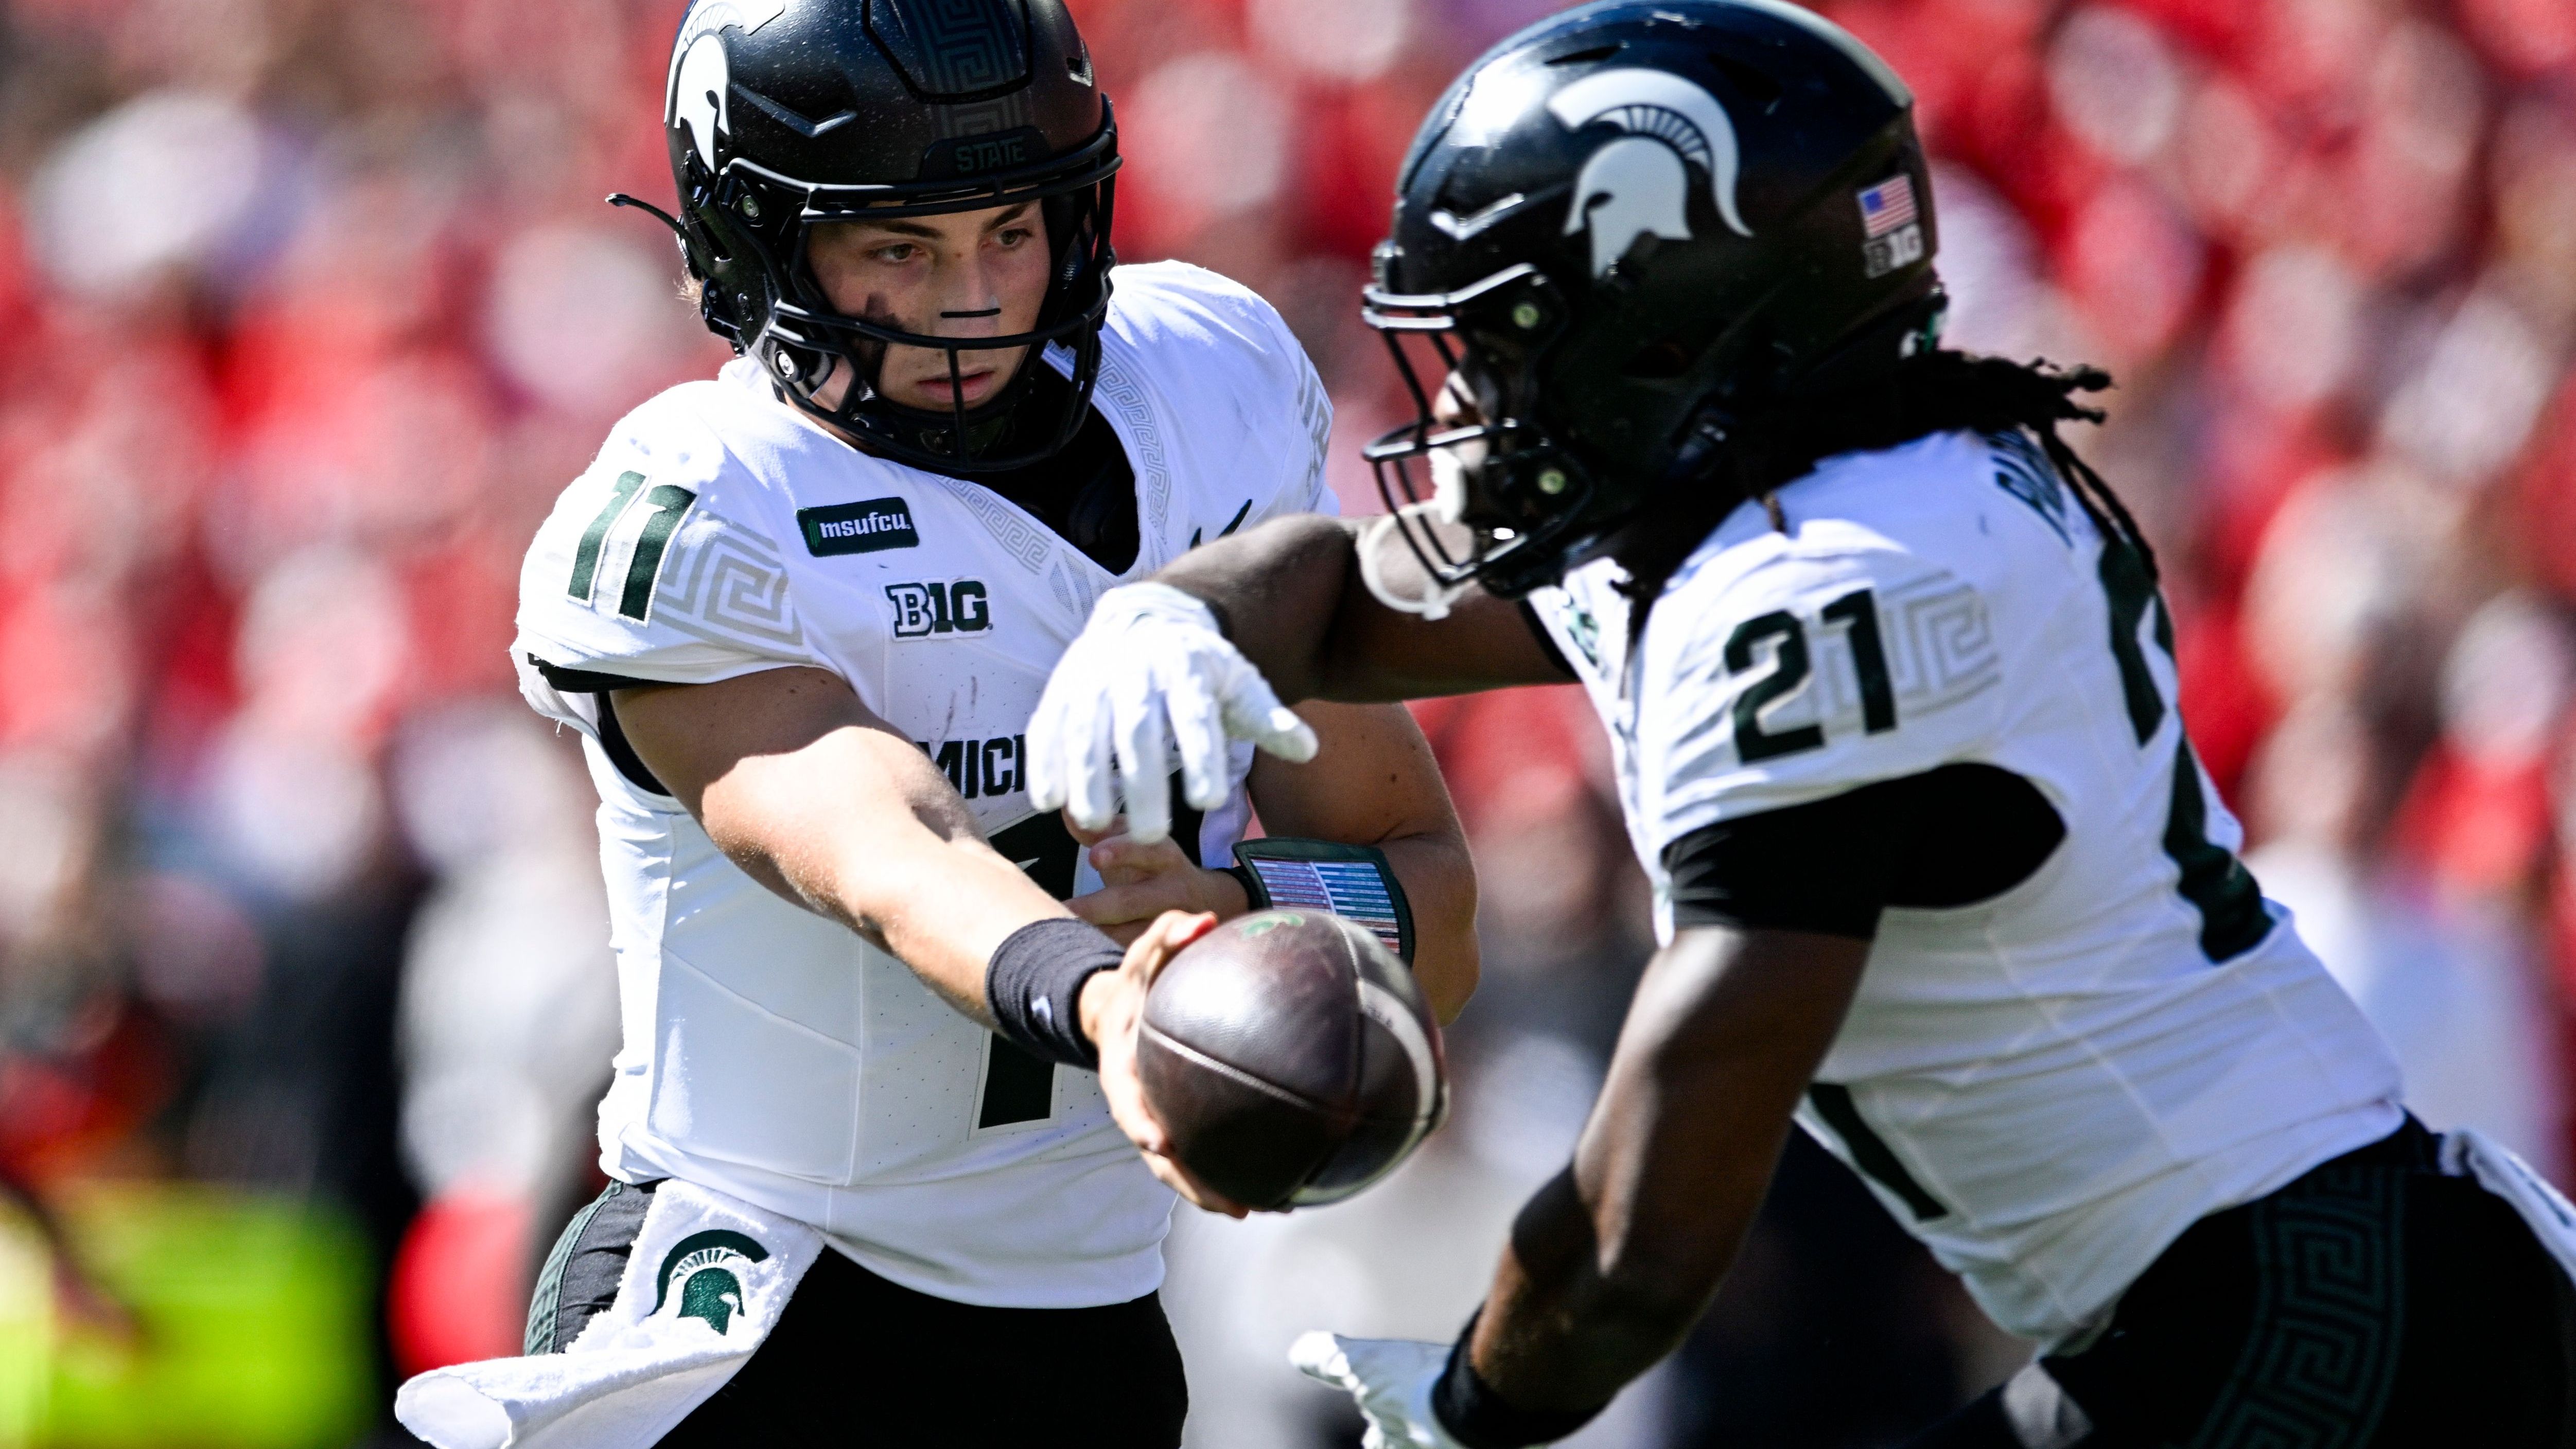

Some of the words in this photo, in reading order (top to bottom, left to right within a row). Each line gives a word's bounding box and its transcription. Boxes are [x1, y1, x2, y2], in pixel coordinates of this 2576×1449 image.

[955, 135, 1026, 173] STATE
[568, 470, 697, 623] 11
[820, 512, 907, 538] msufcu
[1724, 588, 1896, 764] 21
